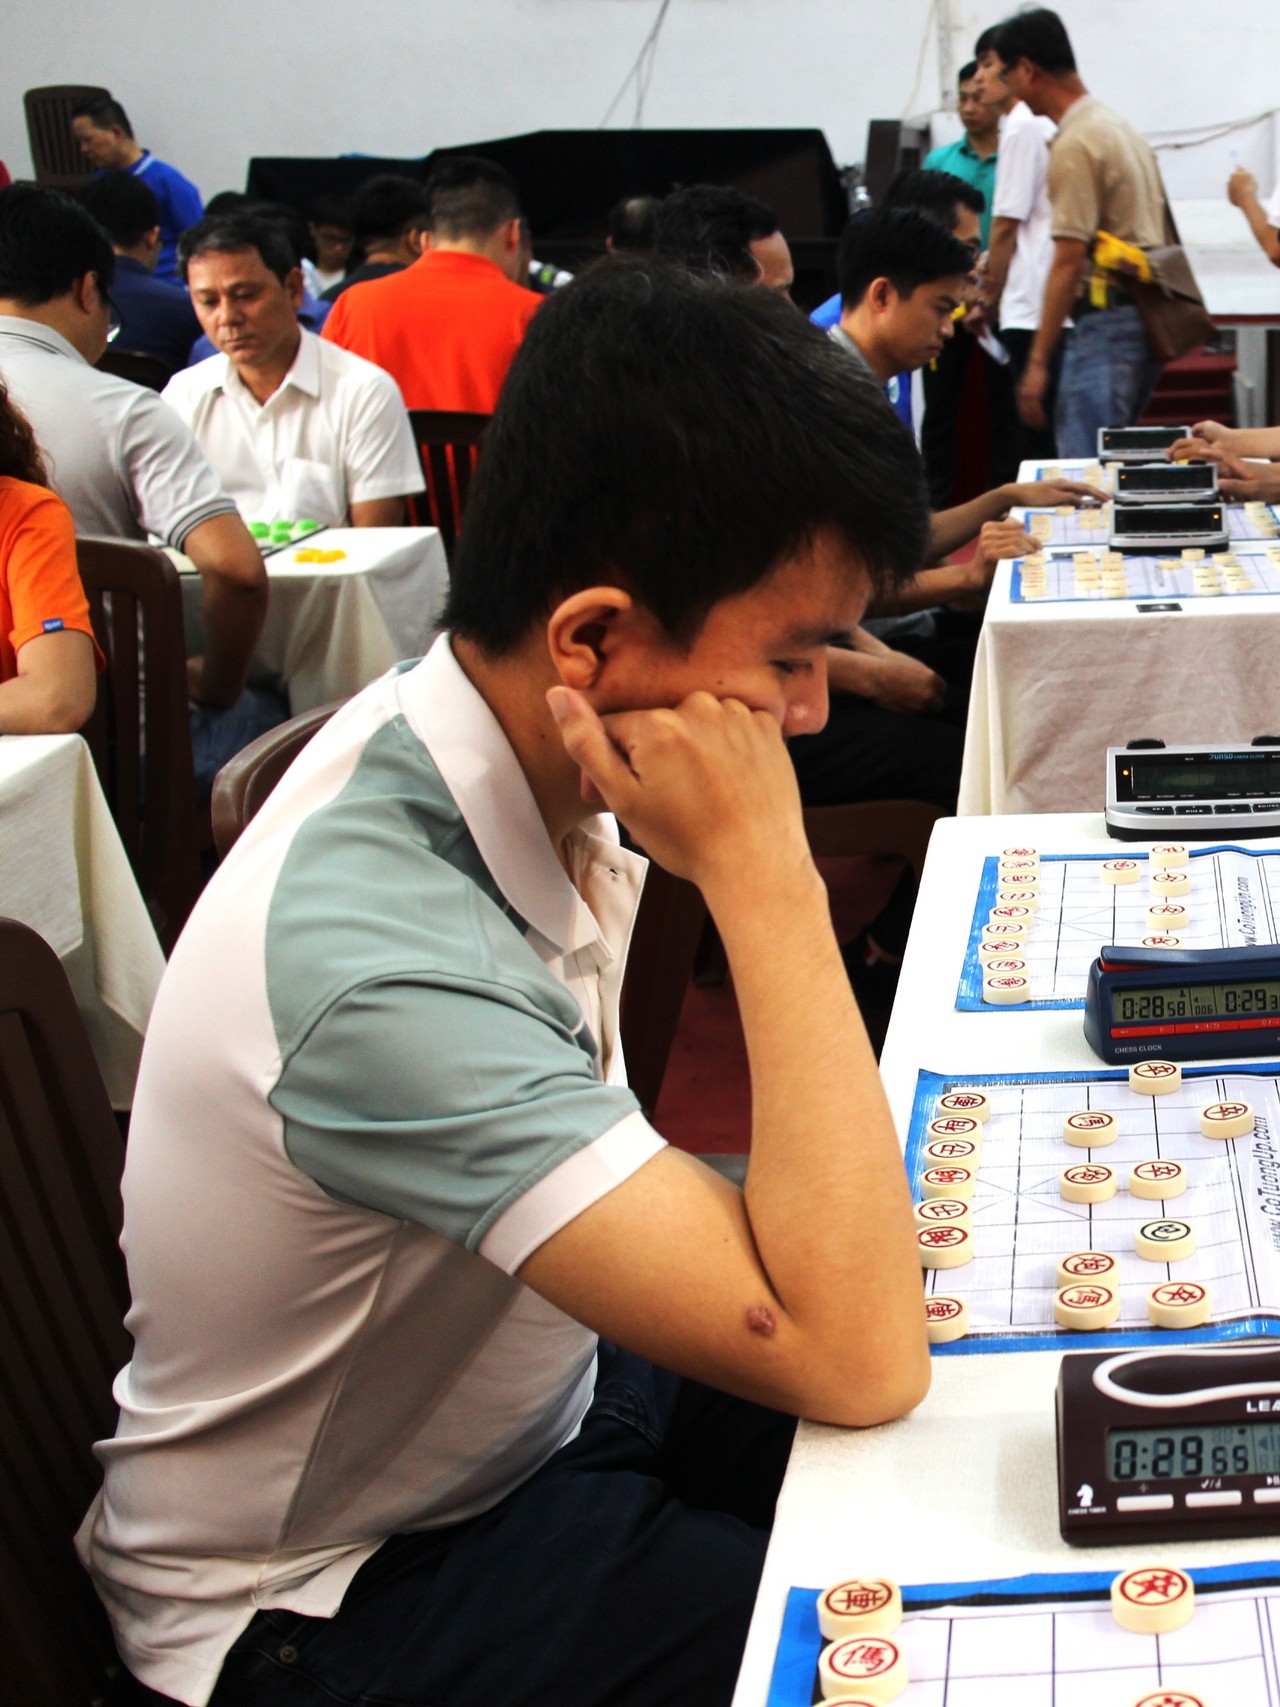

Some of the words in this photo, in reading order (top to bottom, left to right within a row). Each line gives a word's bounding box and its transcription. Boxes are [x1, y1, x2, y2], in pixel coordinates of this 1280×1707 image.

[1122, 996, 1164, 1020] 0:28
[1167, 1001, 1186, 1017] 58
[1225, 989, 1267, 1013] 0:29
[1115, 1046, 1137, 1054] CHESS
[1139, 1044, 1162, 1052] CLOCK
[1114, 1436, 1204, 1480] 0:29
